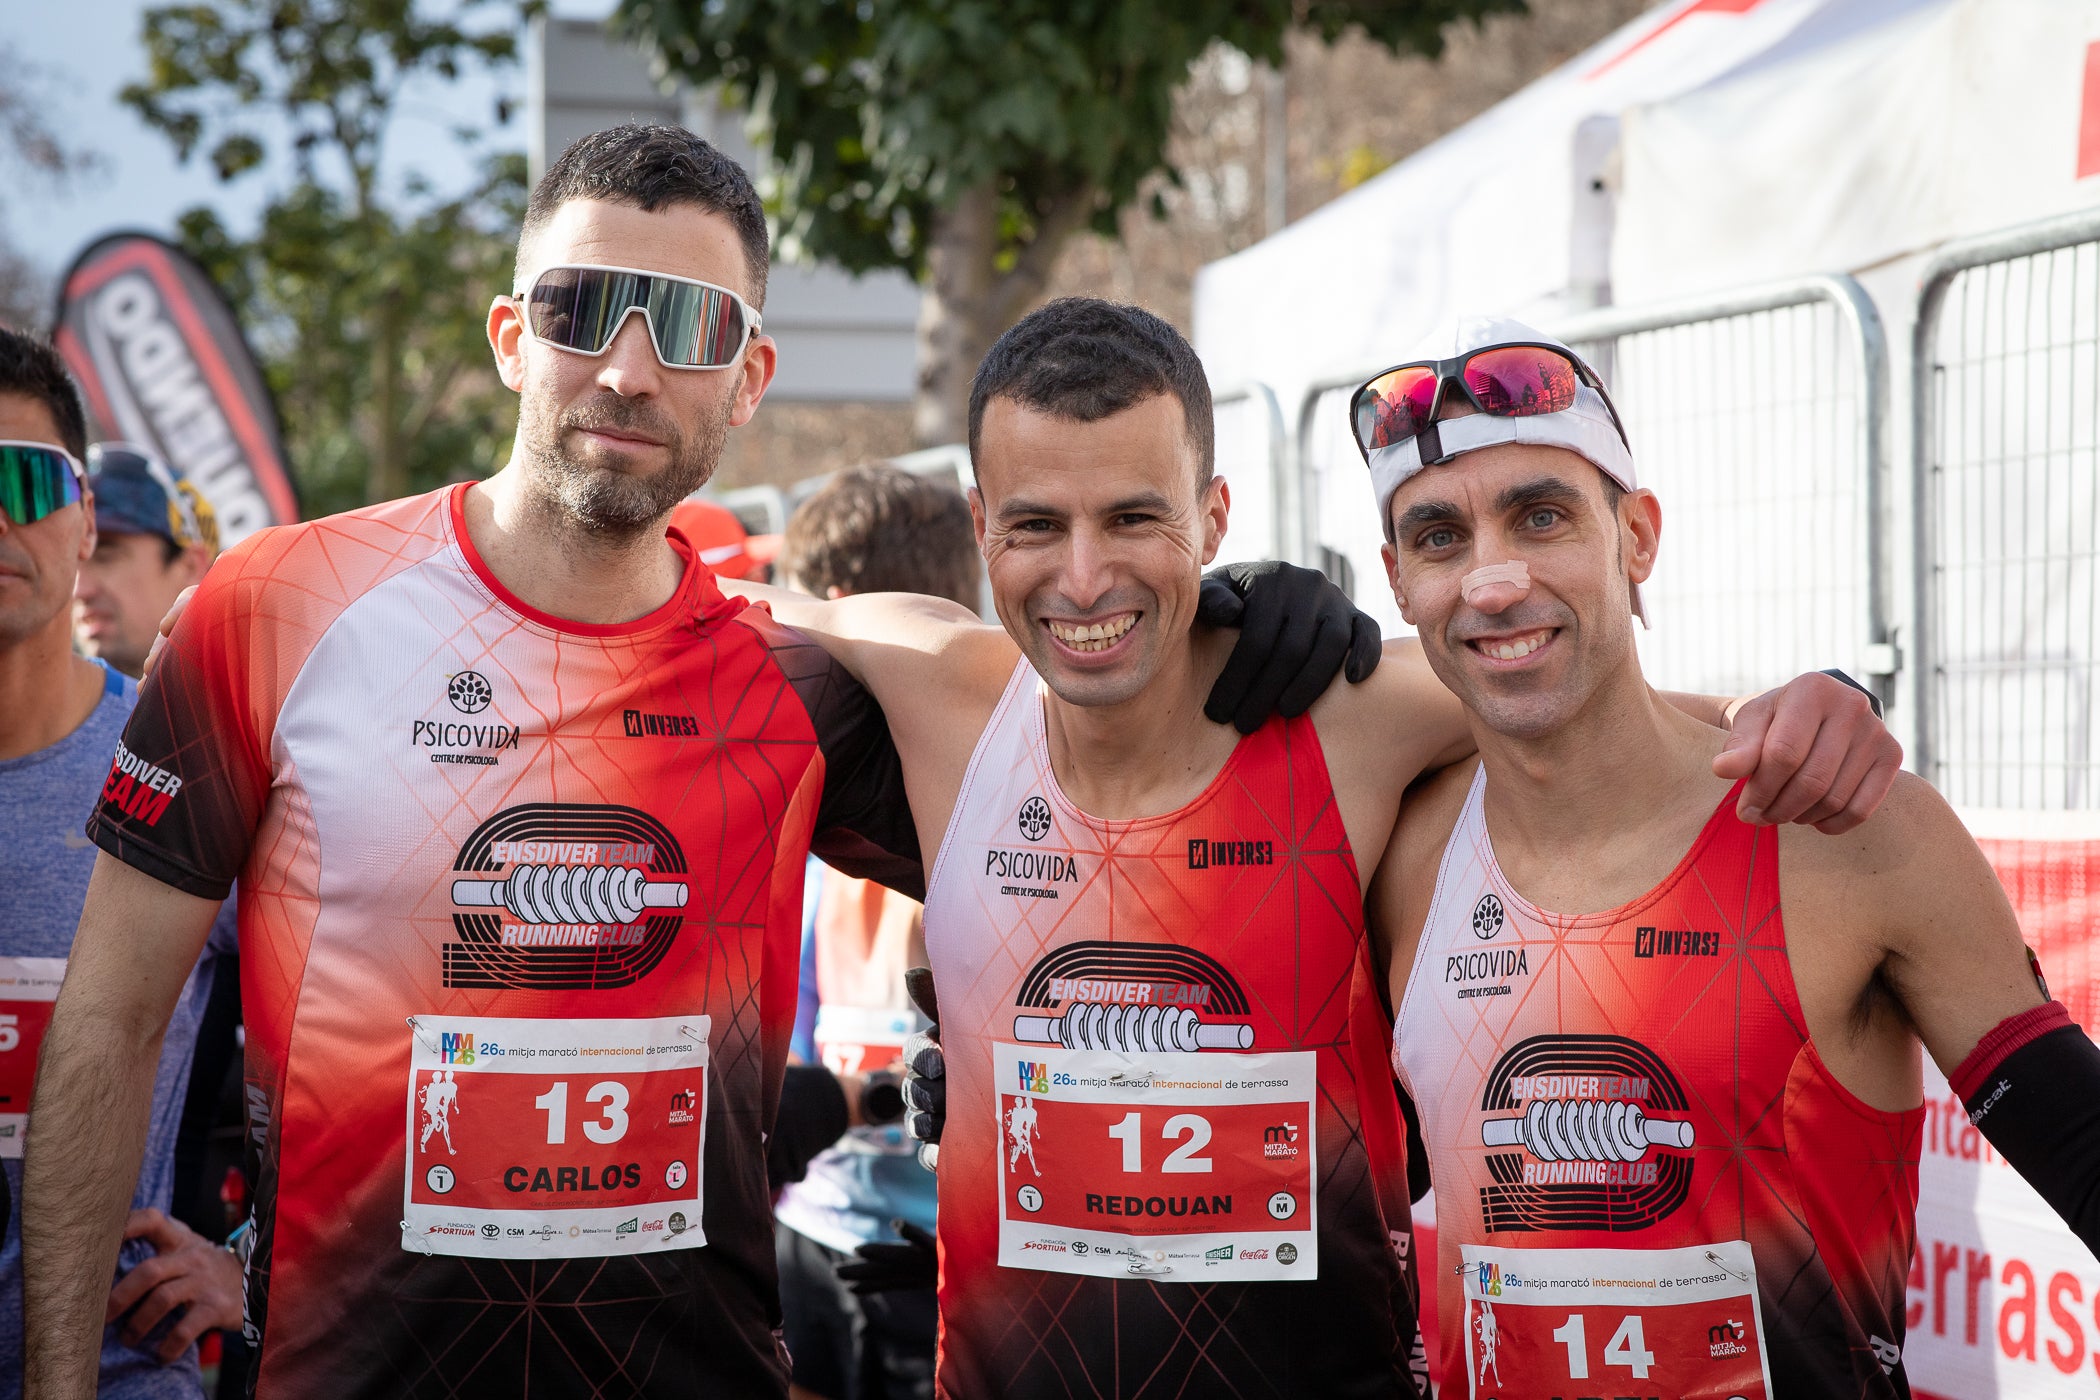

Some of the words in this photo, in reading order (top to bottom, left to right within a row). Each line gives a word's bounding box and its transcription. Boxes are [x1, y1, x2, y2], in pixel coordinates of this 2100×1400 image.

[412, 720, 520, 750] PSICOVIDA
[430, 754, 455, 764] CENTRE
[455, 755, 465, 765] DE
[465, 755, 499, 766] PSICOLOGIA
[102, 760, 173, 827] EAM
[491, 841, 655, 864] ENSDIVERTEAM
[986, 850, 1078, 883] PSICOVIDA
[1001, 886, 1020, 897] CENTRE
[1020, 887, 1027, 898] DE
[1026, 887, 1059, 899] PSICOLOGIA
[500, 923, 648, 946] RUNNINGCLUB
[1445, 949, 1528, 983] PSICOVIDA
[1050, 979, 1211, 1005] ENSDIVERTEAM
[1457, 988, 1476, 999] CENTRE
[1476, 989, 1482, 998] DE
[1482, 985, 1512, 998] PSICOLOGIA
[480, 1042, 505, 1056] 26a
[508, 1046, 536, 1059] mitja
[539, 1045, 578, 1057] marató
[580, 1046, 644, 1056] internacional
[646, 1045, 656, 1055] de
[656, 1044, 692, 1054] terrassa
[1052, 1072, 1077, 1086] 26a
[1080, 1077, 1107, 1090] mitja
[1110, 1076, 1150, 1088] marató
[1152, 1079, 1222, 1089] internacional
[1225, 1079, 1239, 1089] de
[1241, 1078, 1289, 1089] terrassa
[1511, 1076, 1650, 1100] ENSDIVERTEAM
[535, 1081, 630, 1145] 13
[669, 1114, 694, 1123] MARATÓ
[1108, 1112, 1213, 1173] 12
[1264, 1147, 1298, 1156] MARATÓ
[437, 1175, 443, 1188] 1
[503, 1162, 641, 1193] CARLOS
[673, 1172, 679, 1182] L
[1523, 1162, 1659, 1185] RUNNINGCLUB
[1027, 1195, 1033, 1207] 1
[1085, 1193, 1232, 1217] REDOUAN
[1276, 1203, 1288, 1213] M
[424, 1225, 475, 1236] SPORTIUM
[506, 1228, 525, 1236] CSM
[1019, 1241, 1067, 1253] SPORTIUM
[1094, 1246, 1111, 1255] CSM
[1504, 1273, 1522, 1287] 26a
[1523, 1278, 1548, 1291] mitja
[1550, 1277, 1590, 1288] marató
[1592, 1278, 1657, 1289] internacional
[1659, 1277, 1673, 1288] de
[1676, 1273, 1727, 1287] terrassa
[1553, 1314, 1655, 1379] 14
[1710, 1341, 1735, 1351] MITJA
[1711, 1344, 1747, 1357] MARATÓ
